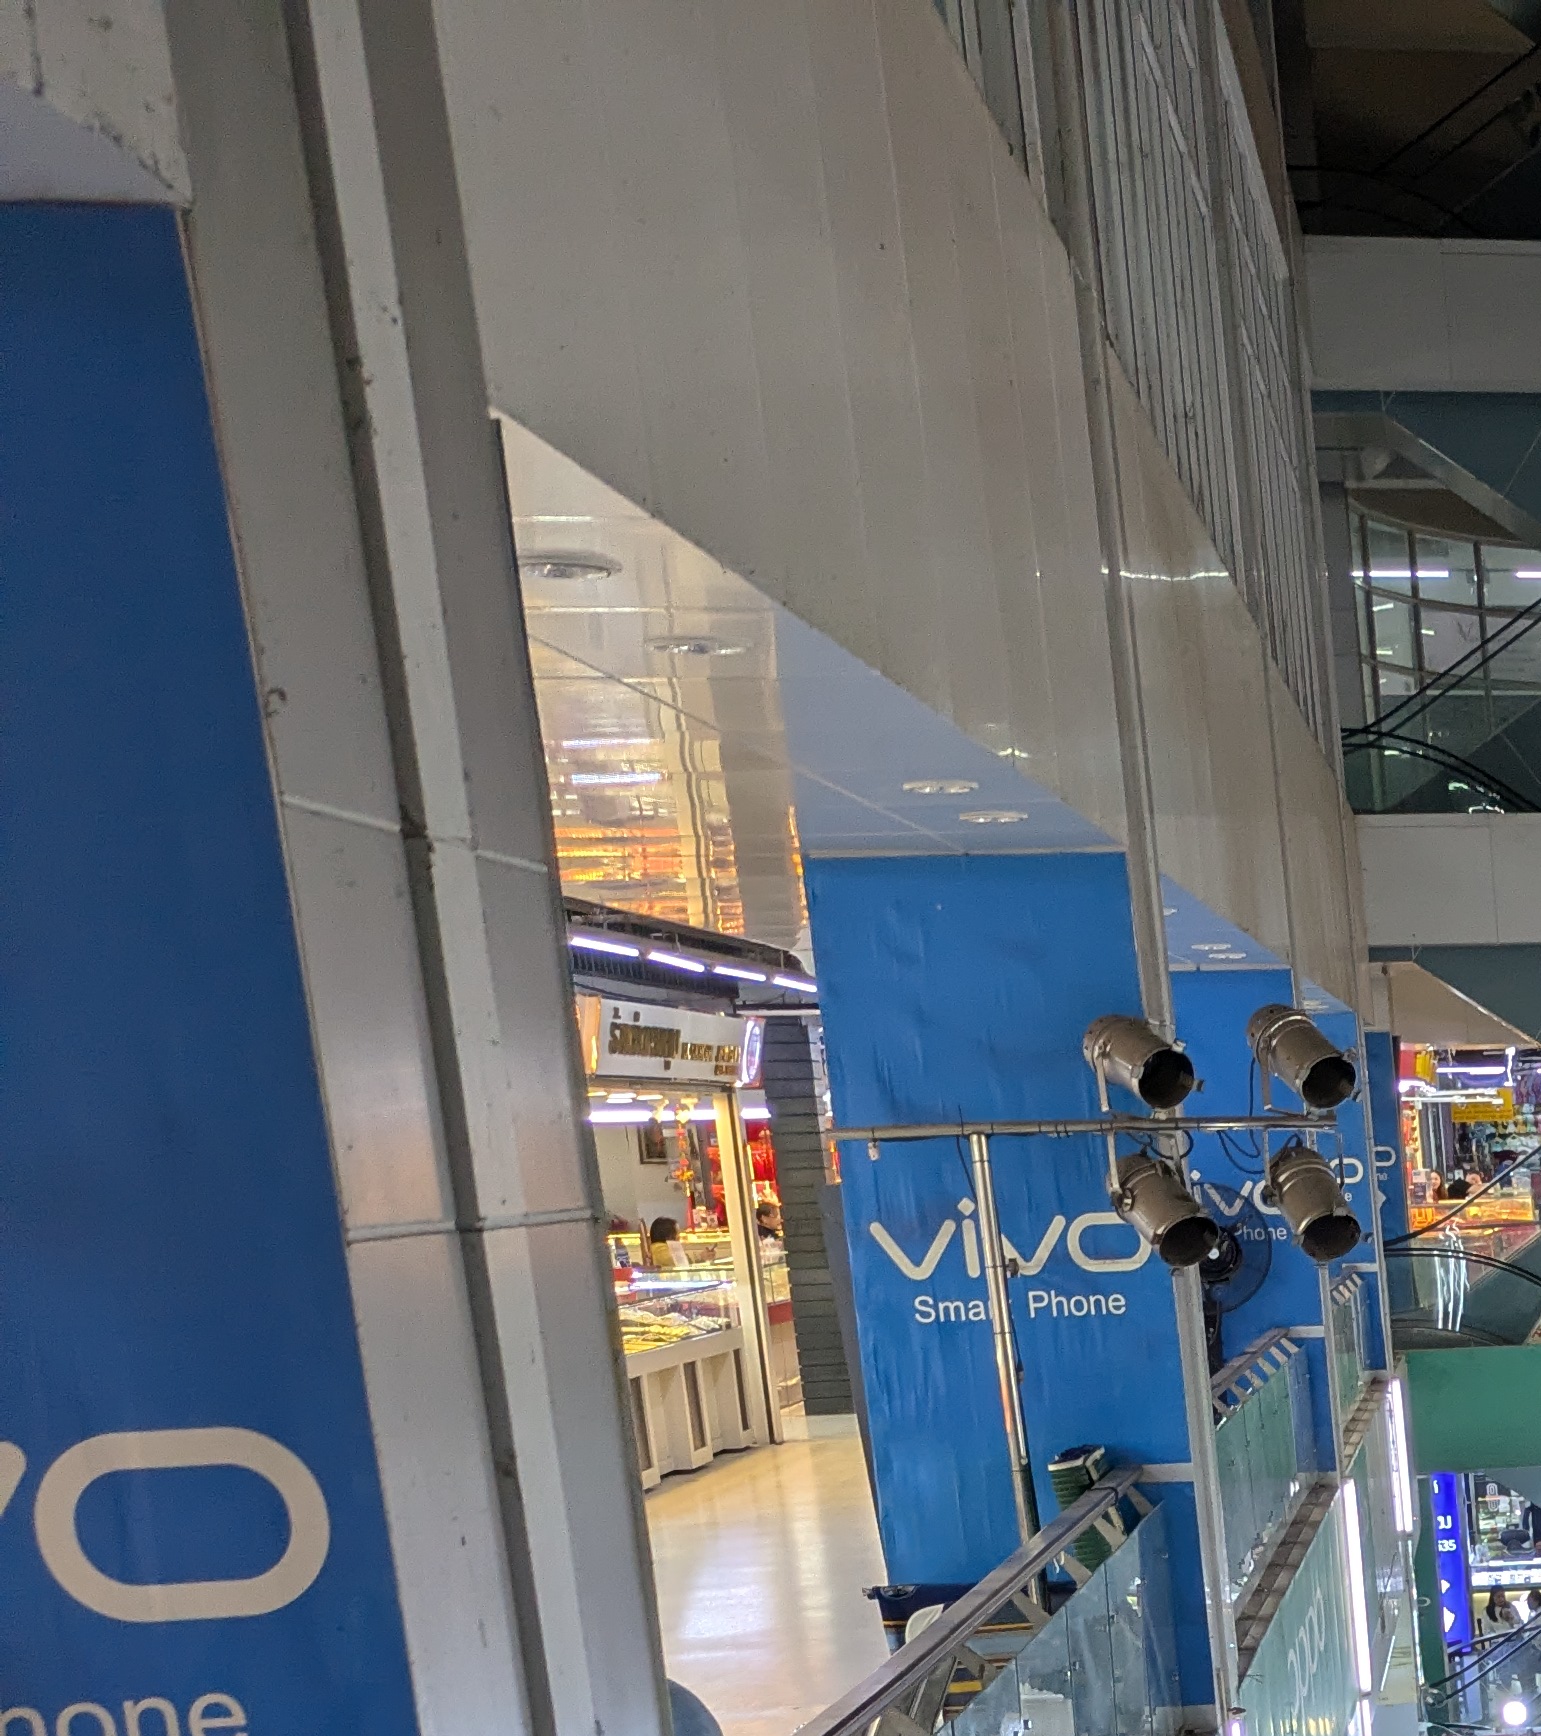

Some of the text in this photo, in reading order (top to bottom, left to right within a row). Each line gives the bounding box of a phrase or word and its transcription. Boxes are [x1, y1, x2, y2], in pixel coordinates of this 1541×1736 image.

[869, 1197, 1153, 1281] vivo
[914, 1289, 1127, 1324] Sma Phone
